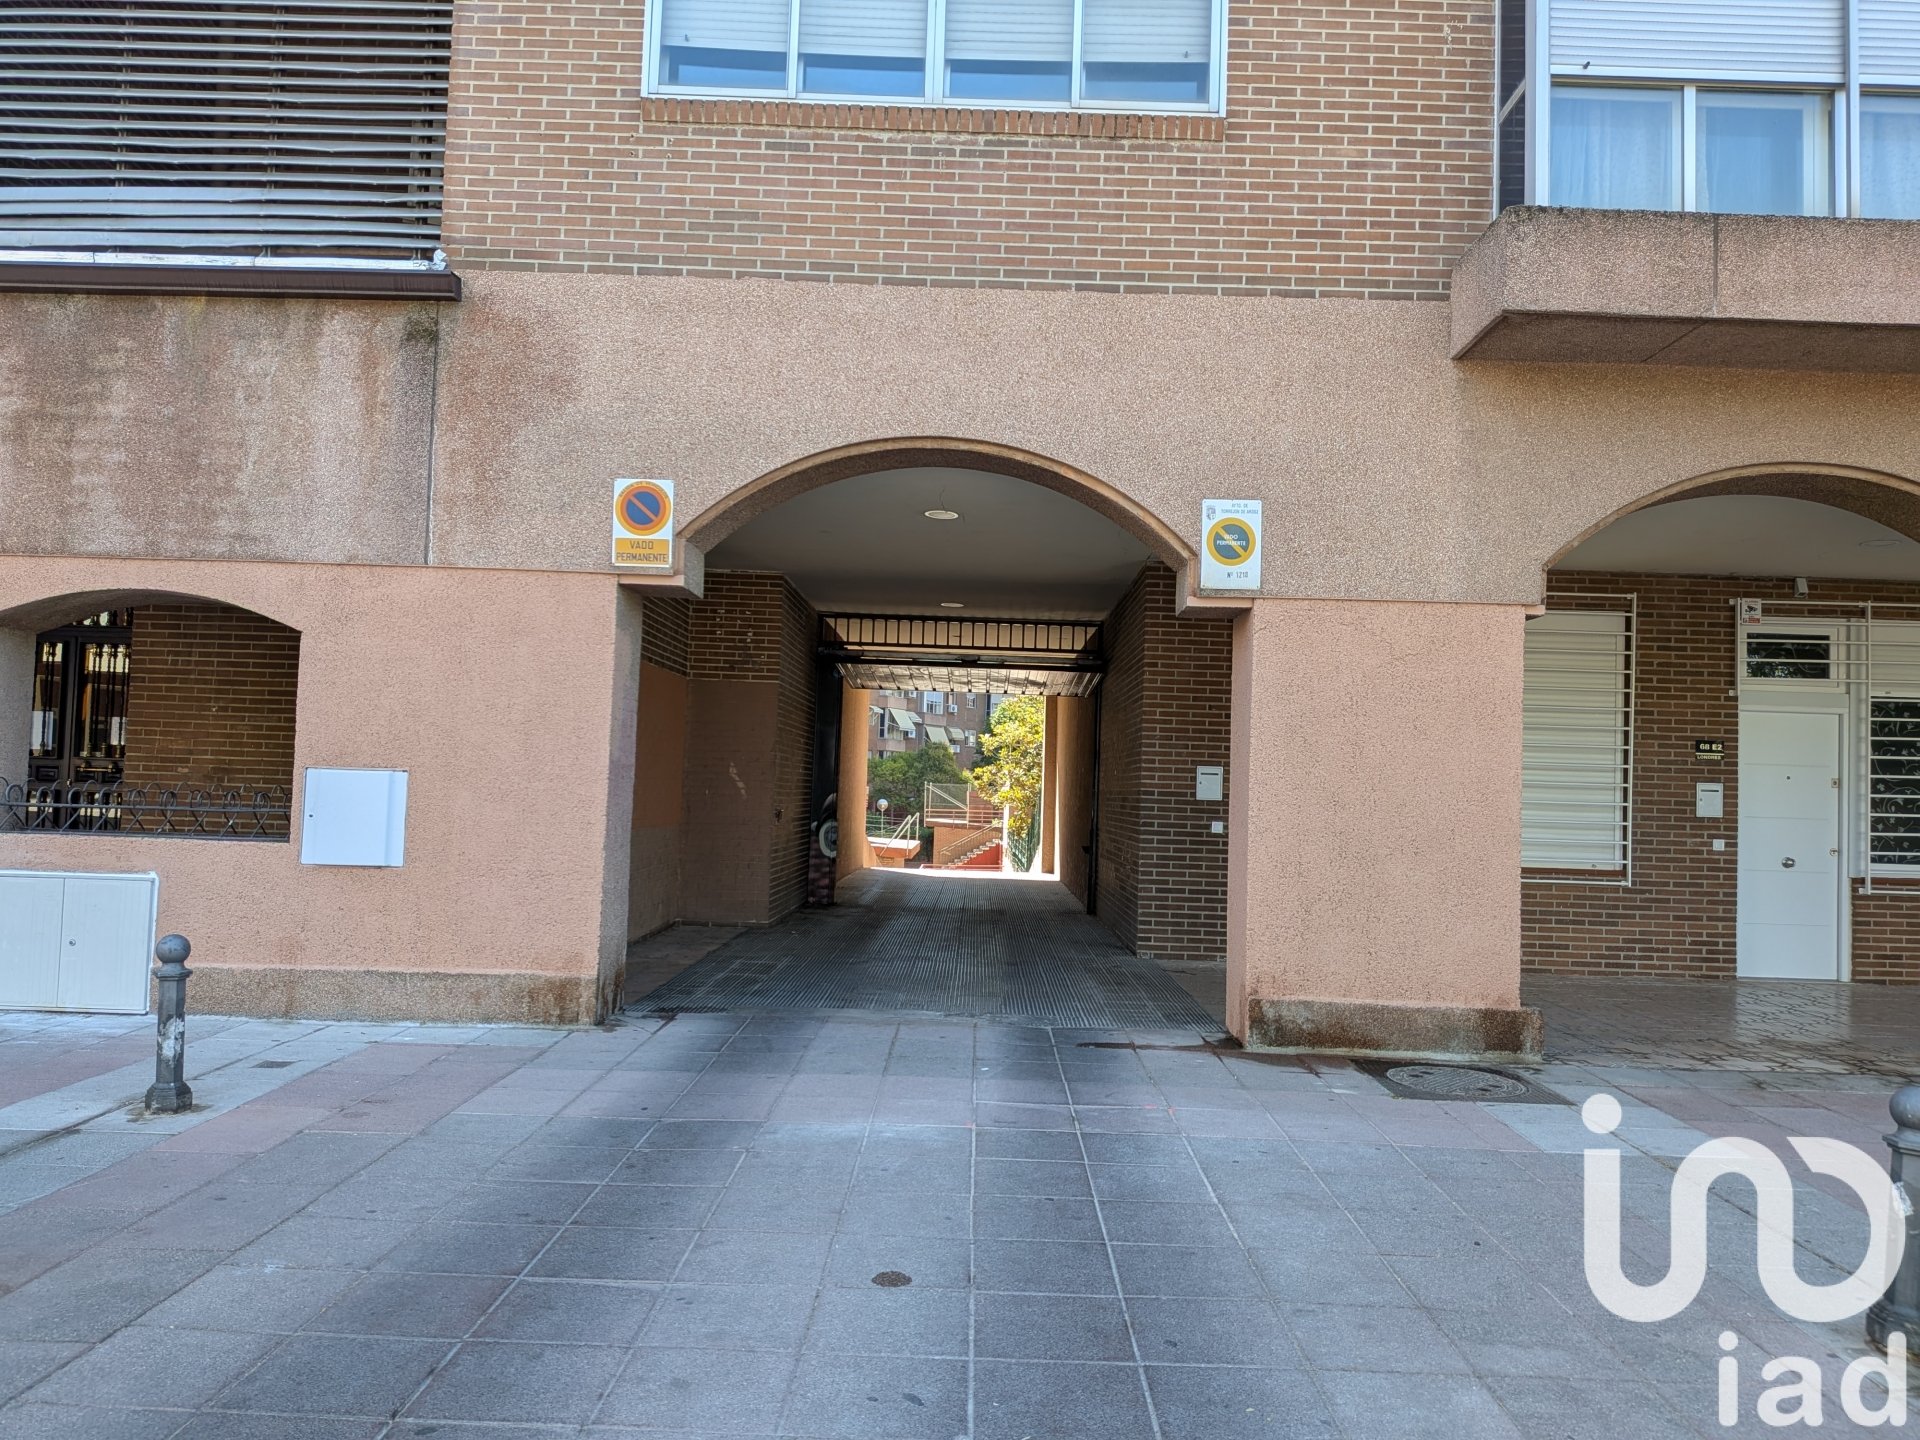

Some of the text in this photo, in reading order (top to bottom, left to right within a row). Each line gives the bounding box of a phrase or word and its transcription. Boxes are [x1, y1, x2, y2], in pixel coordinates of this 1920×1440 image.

[629, 540, 654, 550] VADO
[616, 552, 668, 562] PERMANENTE
[1711, 743, 1723, 751] E2
